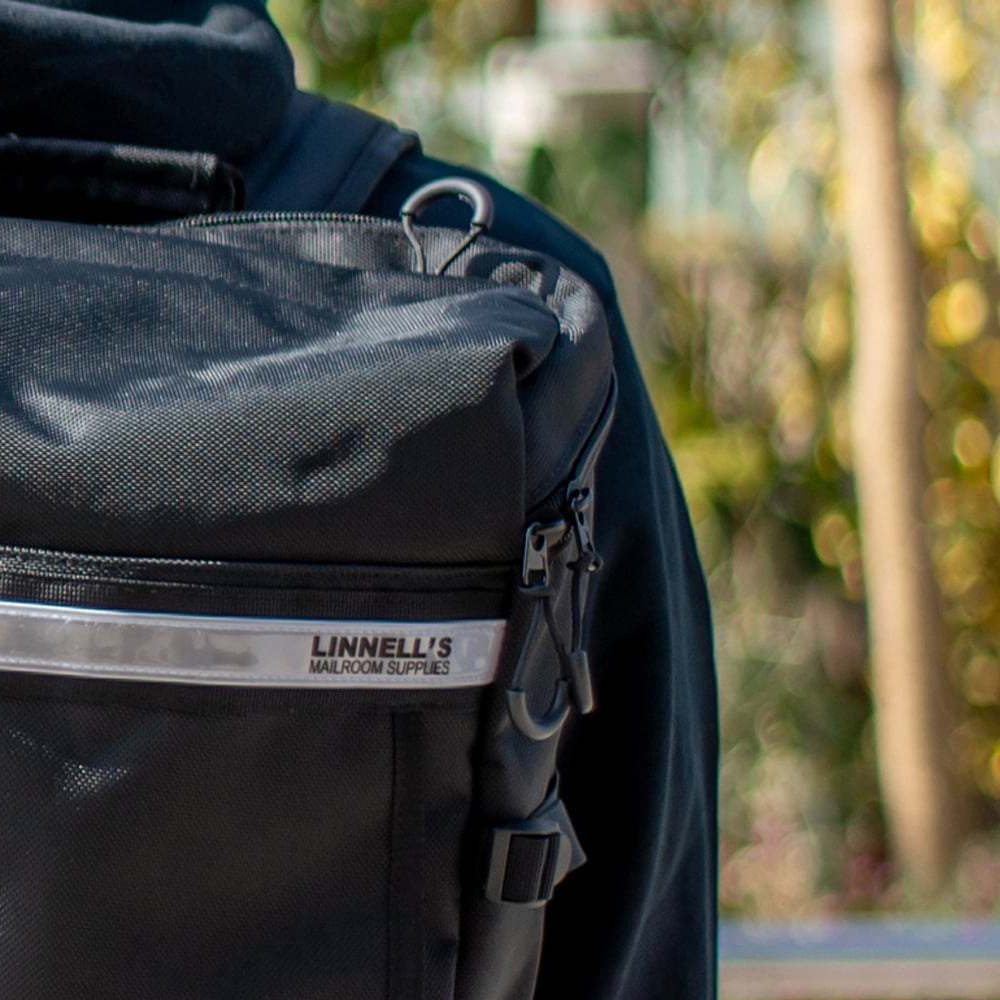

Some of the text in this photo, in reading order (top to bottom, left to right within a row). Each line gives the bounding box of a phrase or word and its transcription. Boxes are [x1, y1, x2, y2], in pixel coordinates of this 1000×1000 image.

[310, 635, 453, 658] LINNELL'S
[308, 659, 451, 676] MAILROOM SUPPLIES
